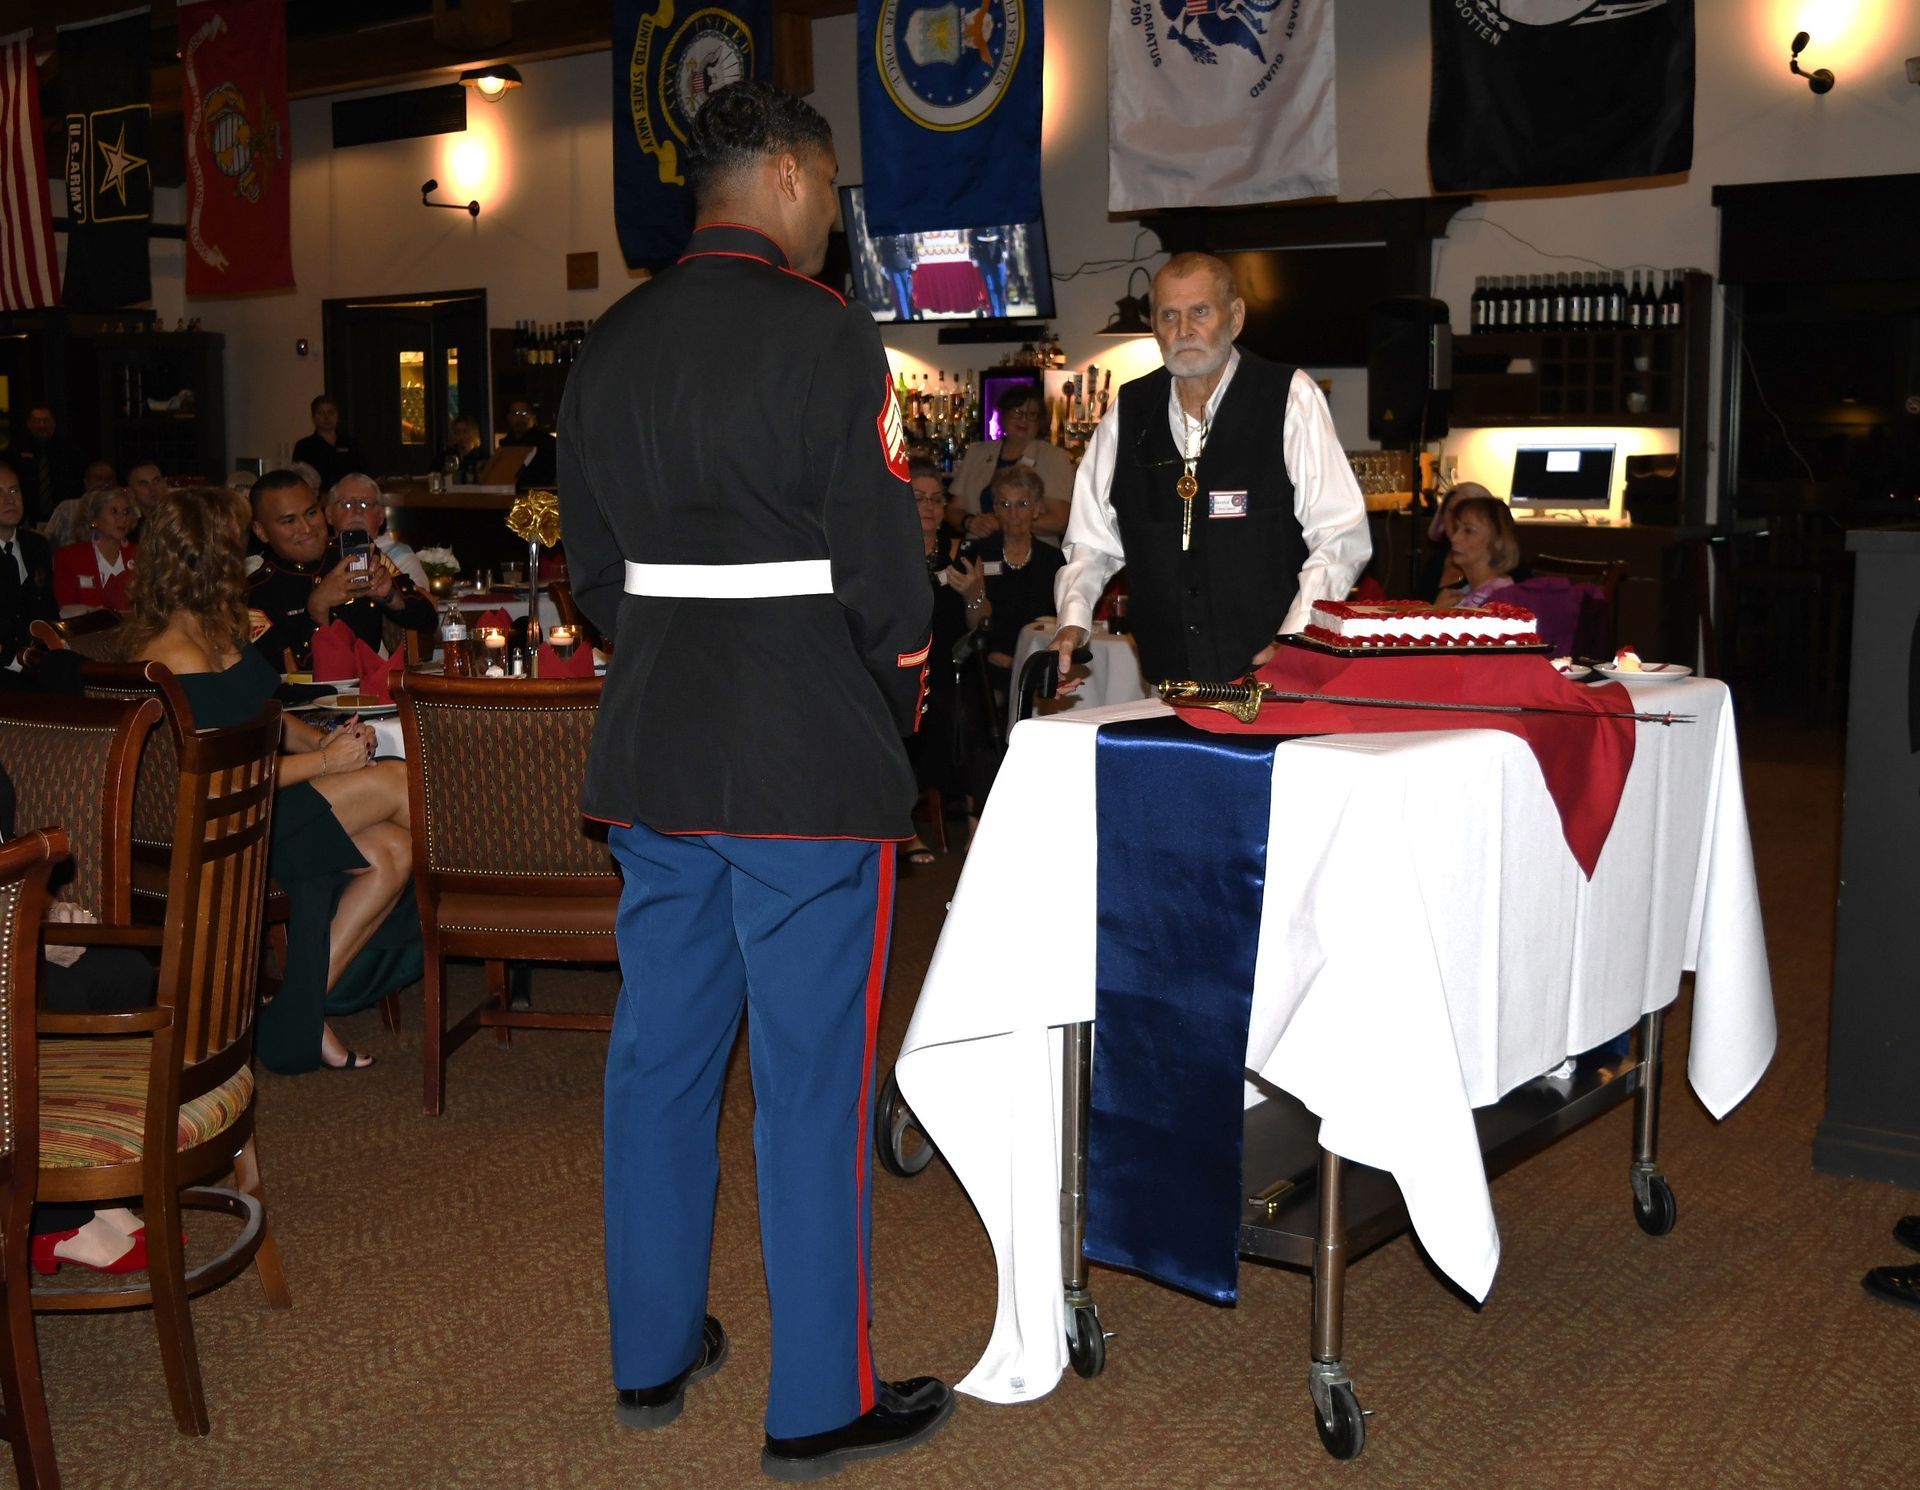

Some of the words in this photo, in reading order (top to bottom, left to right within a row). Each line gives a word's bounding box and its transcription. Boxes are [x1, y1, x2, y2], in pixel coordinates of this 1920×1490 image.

[634, 19, 652, 66] UNITED
[994, 29, 1017, 88] STATES
[1143, 3, 1162, 68] PARATUS
[884, 34, 901, 89] FORCE
[1250, 53, 1284, 98] GUARD
[631, 72, 644, 113] STATES
[636, 117, 654, 148] NAVY
